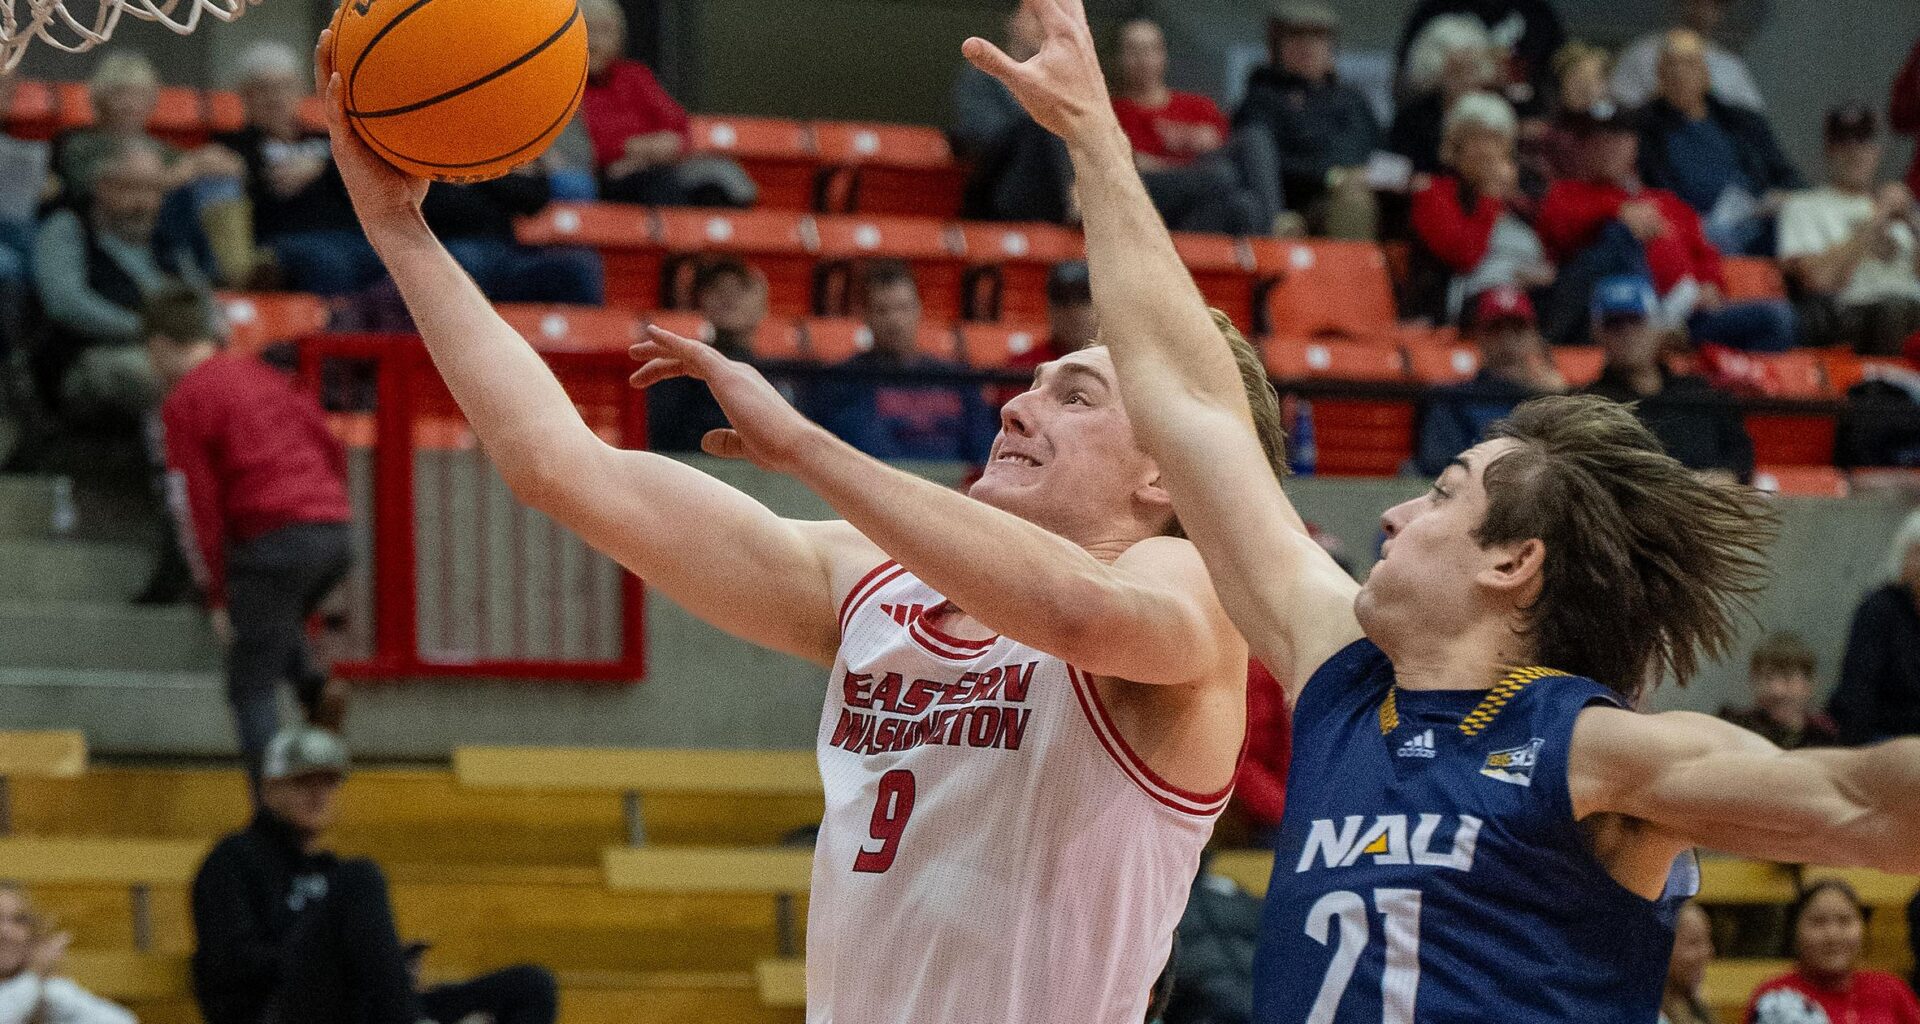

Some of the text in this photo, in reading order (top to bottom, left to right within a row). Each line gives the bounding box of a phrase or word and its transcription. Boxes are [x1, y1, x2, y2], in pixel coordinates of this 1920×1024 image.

[852, 769, 916, 874] 9
[1295, 813, 1483, 873] NAU
[1304, 888, 1422, 1024] 21
